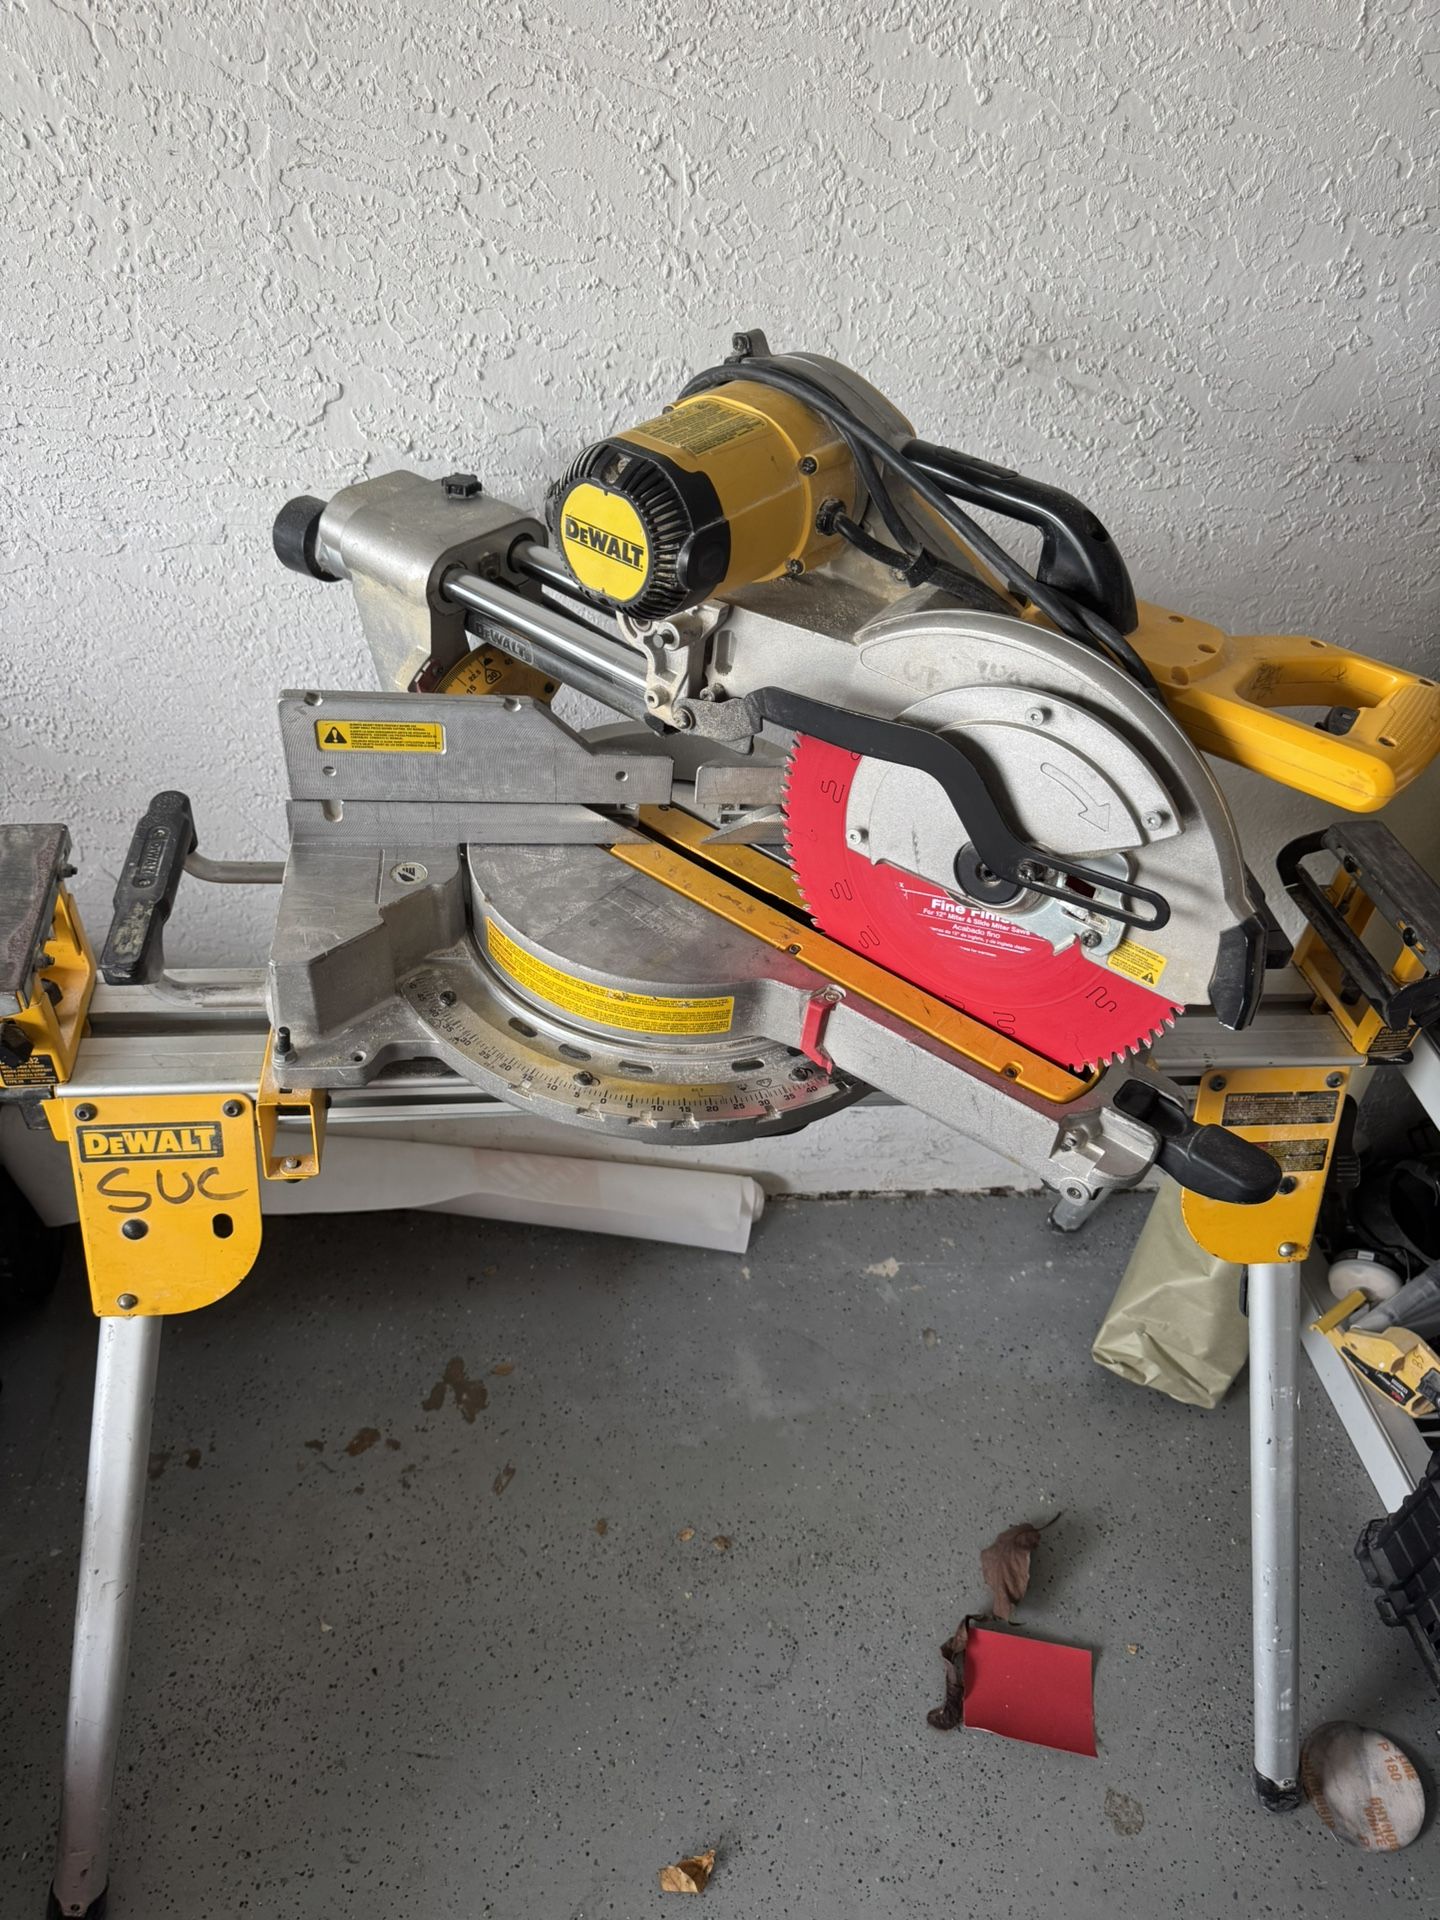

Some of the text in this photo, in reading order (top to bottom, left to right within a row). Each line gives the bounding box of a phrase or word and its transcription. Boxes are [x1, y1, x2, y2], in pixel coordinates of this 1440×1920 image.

[487, 671, 498, 681] 30
[466, 685, 477, 695] 15
[931, 898, 966, 914] Fine
[923, 908, 932, 916] For
[948, 913, 965, 922] Miter
[973, 918, 990, 927] Slide
[991, 922, 1009, 931] Miter
[1011, 926, 1031, 935] Saws
[952, 924, 985, 935] Acabado
[986, 931, 1001, 939] fino
[442, 1023, 454, 1033] 35
[460, 1037, 472, 1046] 30
[479, 1050, 491, 1060] 25
[499, 1061, 512, 1071] 20
[521, 1072, 534, 1081] 15
[546, 1082, 558, 1091] 10
[573, 1090, 580, 1098] 5
[651, 1104, 664, 1112] 10
[679, 1105, 692, 1113] 15
[733, 1102, 745, 1110] 25
[97, 1166, 249, 1213] SUC
[1377, 1741, 1402, 1781] P 180
